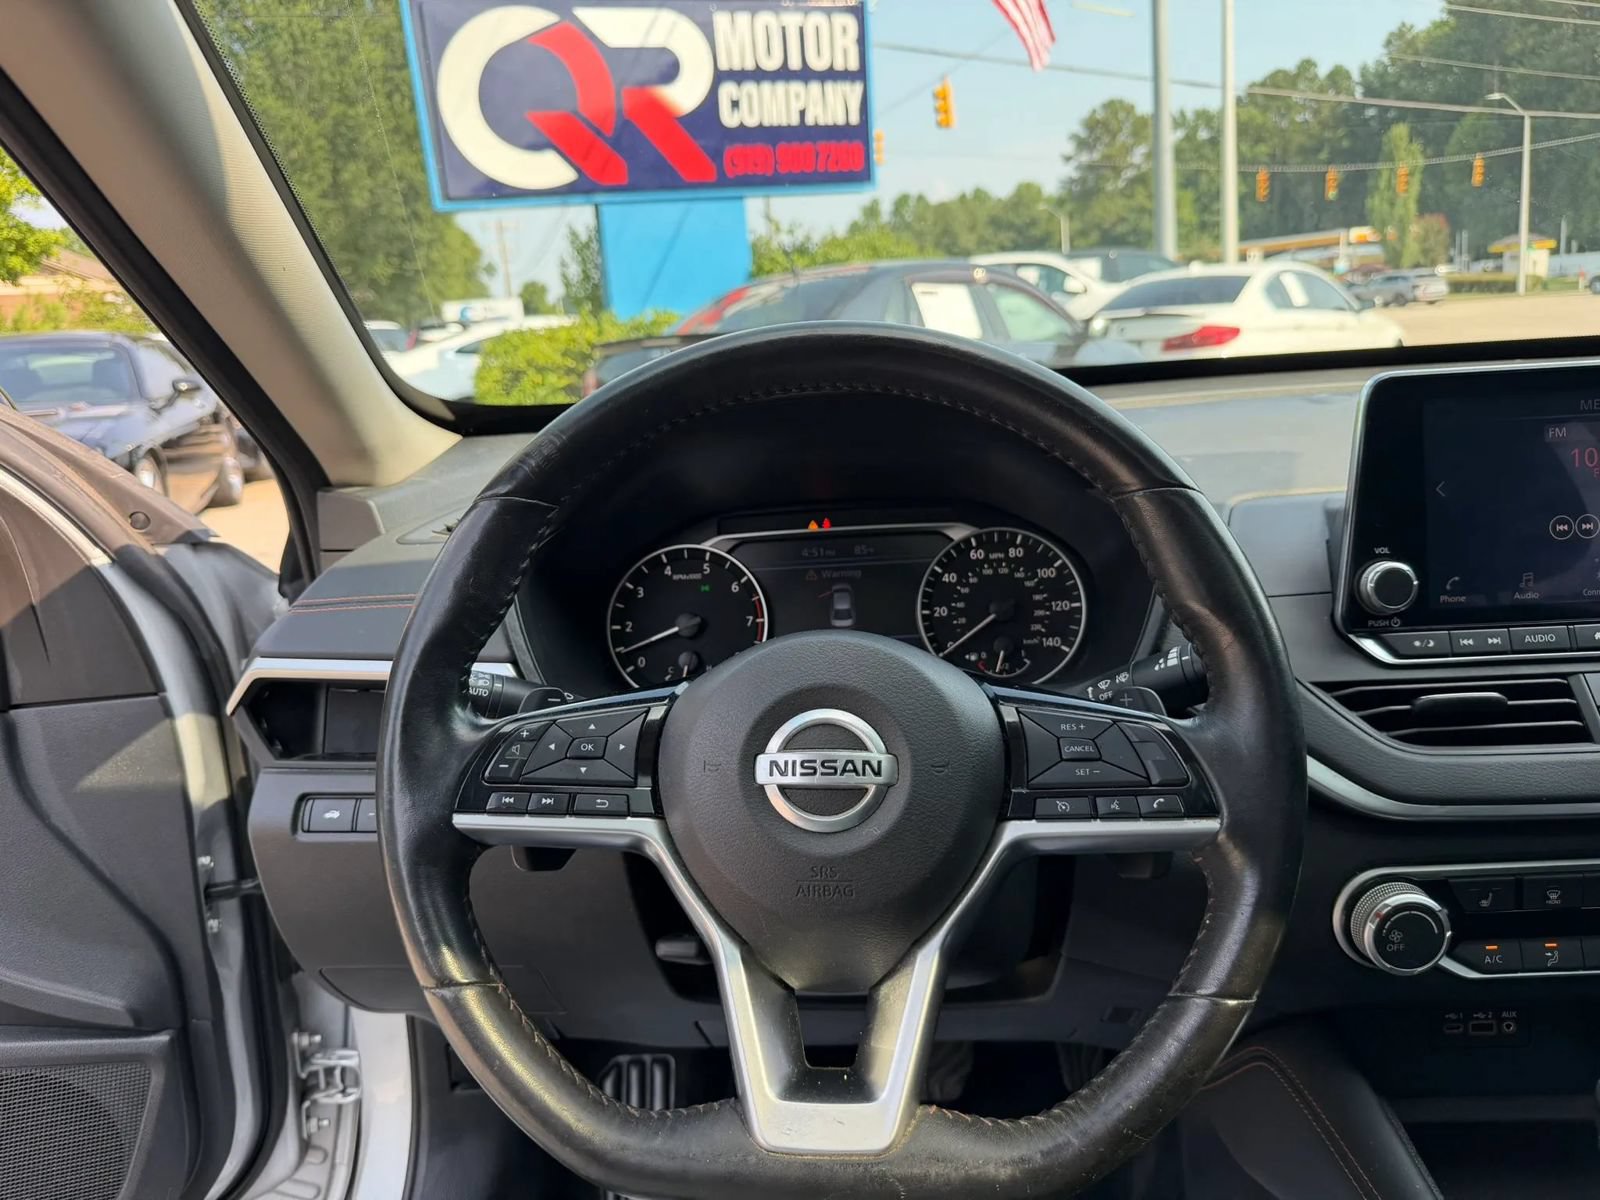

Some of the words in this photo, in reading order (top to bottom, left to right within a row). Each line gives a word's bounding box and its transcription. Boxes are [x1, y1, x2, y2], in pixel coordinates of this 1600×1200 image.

[713, 10, 860, 71] MOTOR
[717, 80, 864, 128] COMPANY
[1548, 427, 1567, 438] FM
[970, 549, 984, 560] 60
[1008, 547, 1024, 558] 80
[664, 567, 673, 578] 4
[703, 564, 711, 574] 5
[1037, 568, 1056, 578] 100
[942, 572, 957, 583] 40
[637, 587, 645, 598] 3
[731, 583, 740, 593] 6
[1440, 595, 1466, 603] Phone
[1514, 591, 1540, 600] Audio
[1052, 600, 1070, 611] 120
[934, 606, 948, 617] 20
[746, 615, 754, 625] 7
[1368, 619, 1390, 627] PUSH
[625, 622, 633, 632] 2
[1042, 637, 1061, 648] 140
[1524, 633, 1556, 643] AUDIO
[638, 656, 646, 668] 0
[469, 688, 489, 697] AUTO
[1099, 691, 1113, 701] OFF
[1060, 723, 1077, 731] RES
[580, 743, 594, 751] OK
[1064, 745, 1095, 753] CANCEL
[768, 759, 883, 778] NISSAN
[810, 866, 838, 879] SRS
[796, 884, 856, 898] AIRBAG
[1387, 943, 1406, 952] OFF
[1484, 954, 1504, 964] A/C
[1502, 1010, 1518, 1019] AUX
